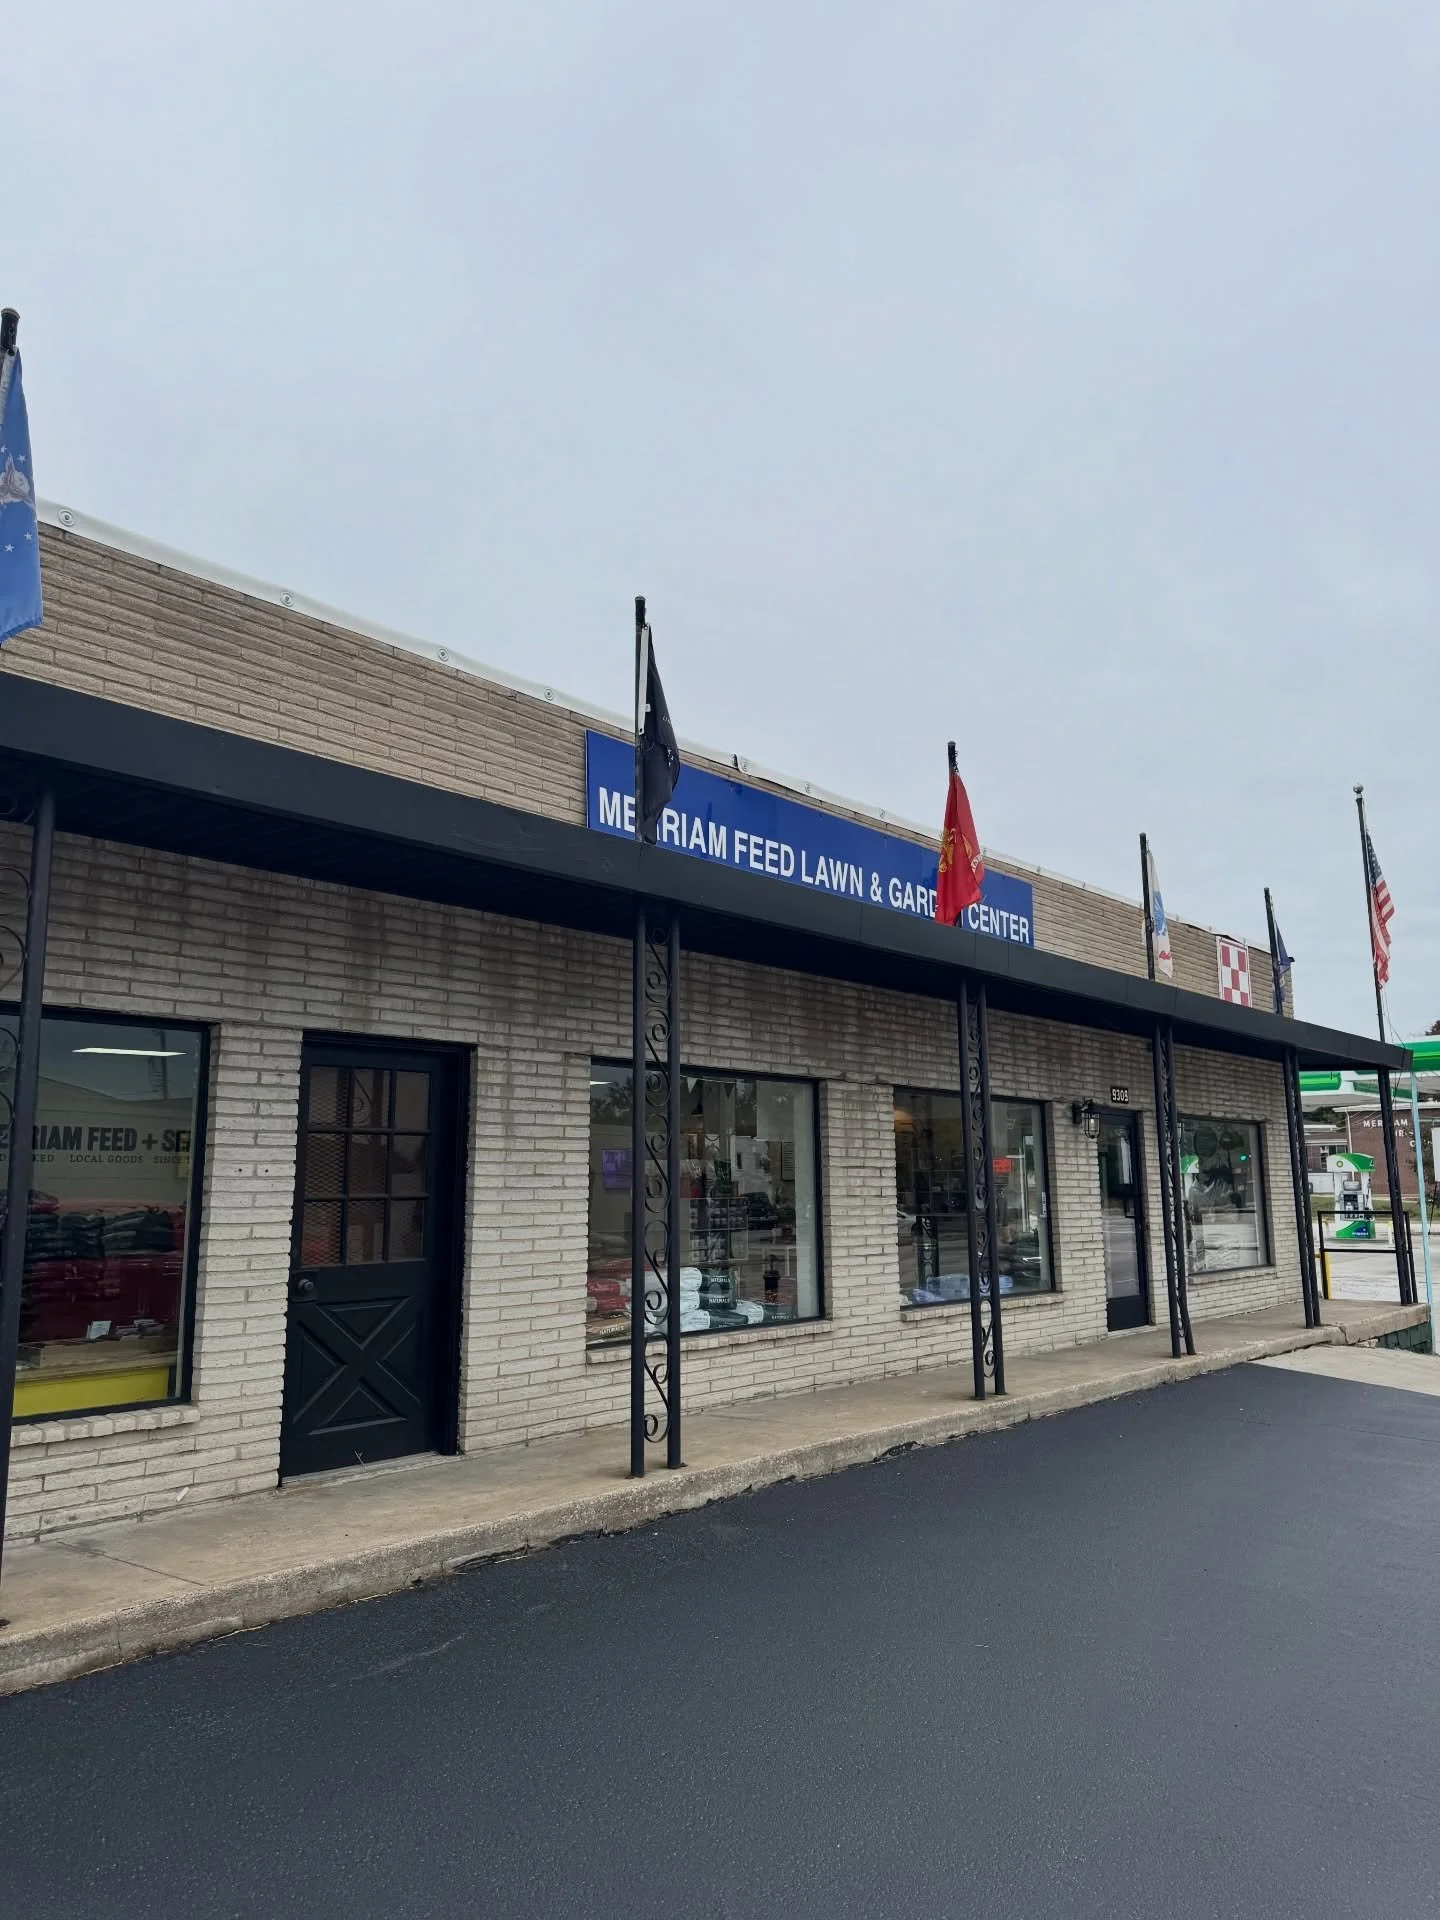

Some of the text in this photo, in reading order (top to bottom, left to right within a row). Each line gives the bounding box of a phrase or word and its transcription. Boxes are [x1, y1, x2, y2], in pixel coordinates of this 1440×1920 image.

[600, 786, 1030, 944] MERIAM FEED LAWN & GARD CENTER
[1363, 1119, 1408, 1128] MERAM
[87, 1126, 138, 1152] FEED
[69, 1154, 104, 1163] LOCAL
[107, 1155, 144, 1164] GOODS
